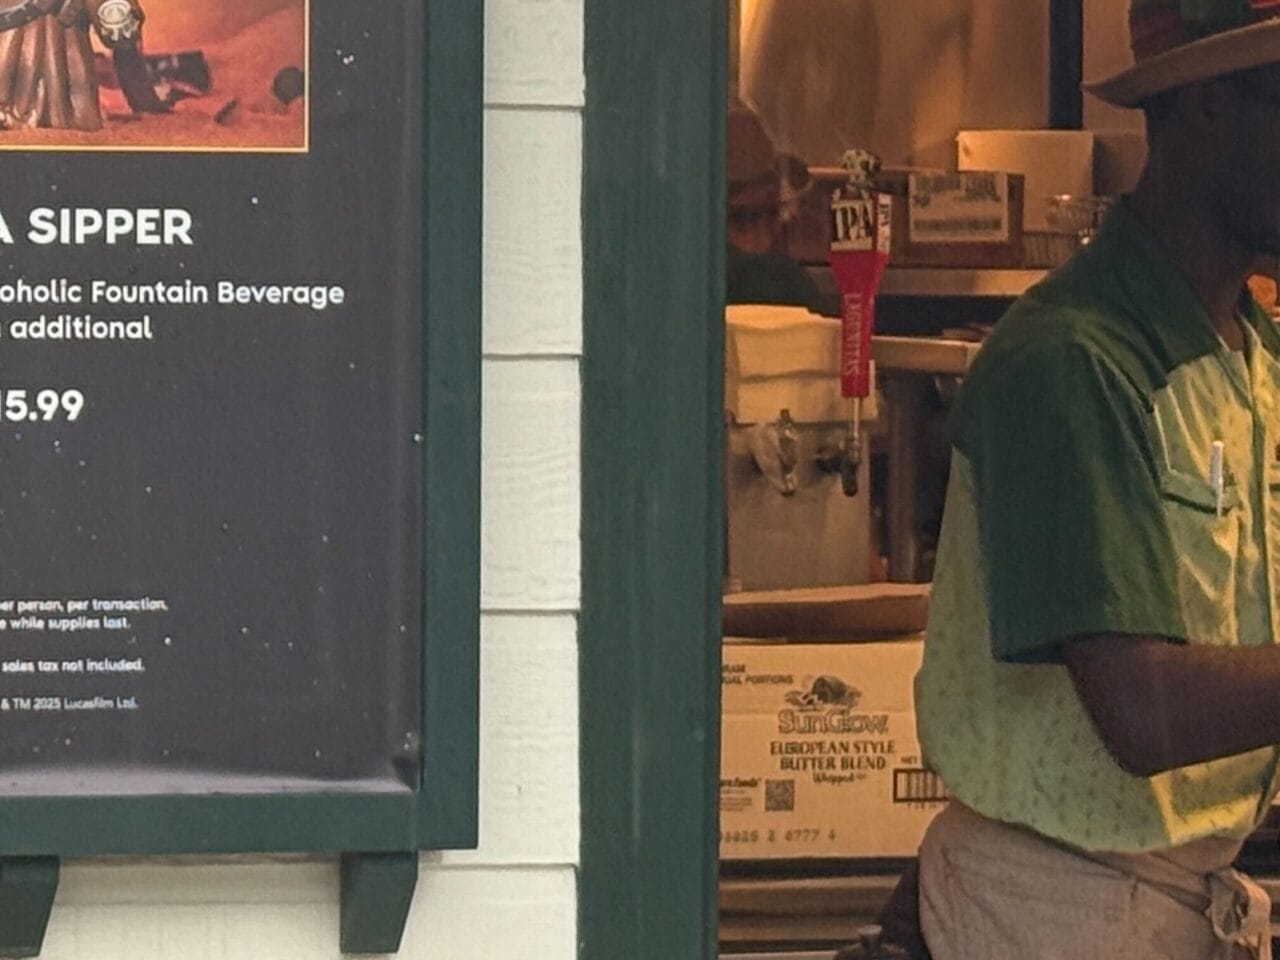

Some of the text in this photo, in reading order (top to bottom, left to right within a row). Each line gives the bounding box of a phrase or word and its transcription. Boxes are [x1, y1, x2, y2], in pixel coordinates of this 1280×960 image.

[28, 208, 192, 244] SIPPER
[92, 280, 208, 303] Fountain
[218, 282, 346, 309] Beverage
[11, 315, 152, 338] additional
[17, 600, 65, 614] person,
[66, 600, 89, 614] per
[91, 596, 169, 611] transaction.
[9, 615, 45, 630] while
[47, 615, 101, 632] supplies
[103, 615, 131, 630] last.
[1, 659, 35, 673] sales
[37, 660, 59, 672] tax
[61, 659, 84, 672] not
[86, 657, 145, 672] included.
[12, 697, 32, 710] TM
[32, 697, 62, 711] 2025
[63, 696, 114, 710] Lucasfilm
[777, 708, 888, 734] SunGlow
[770, 740, 895, 755] EUROPEAN STYLE
[780, 755, 886, 770] BUTTER BLEND
